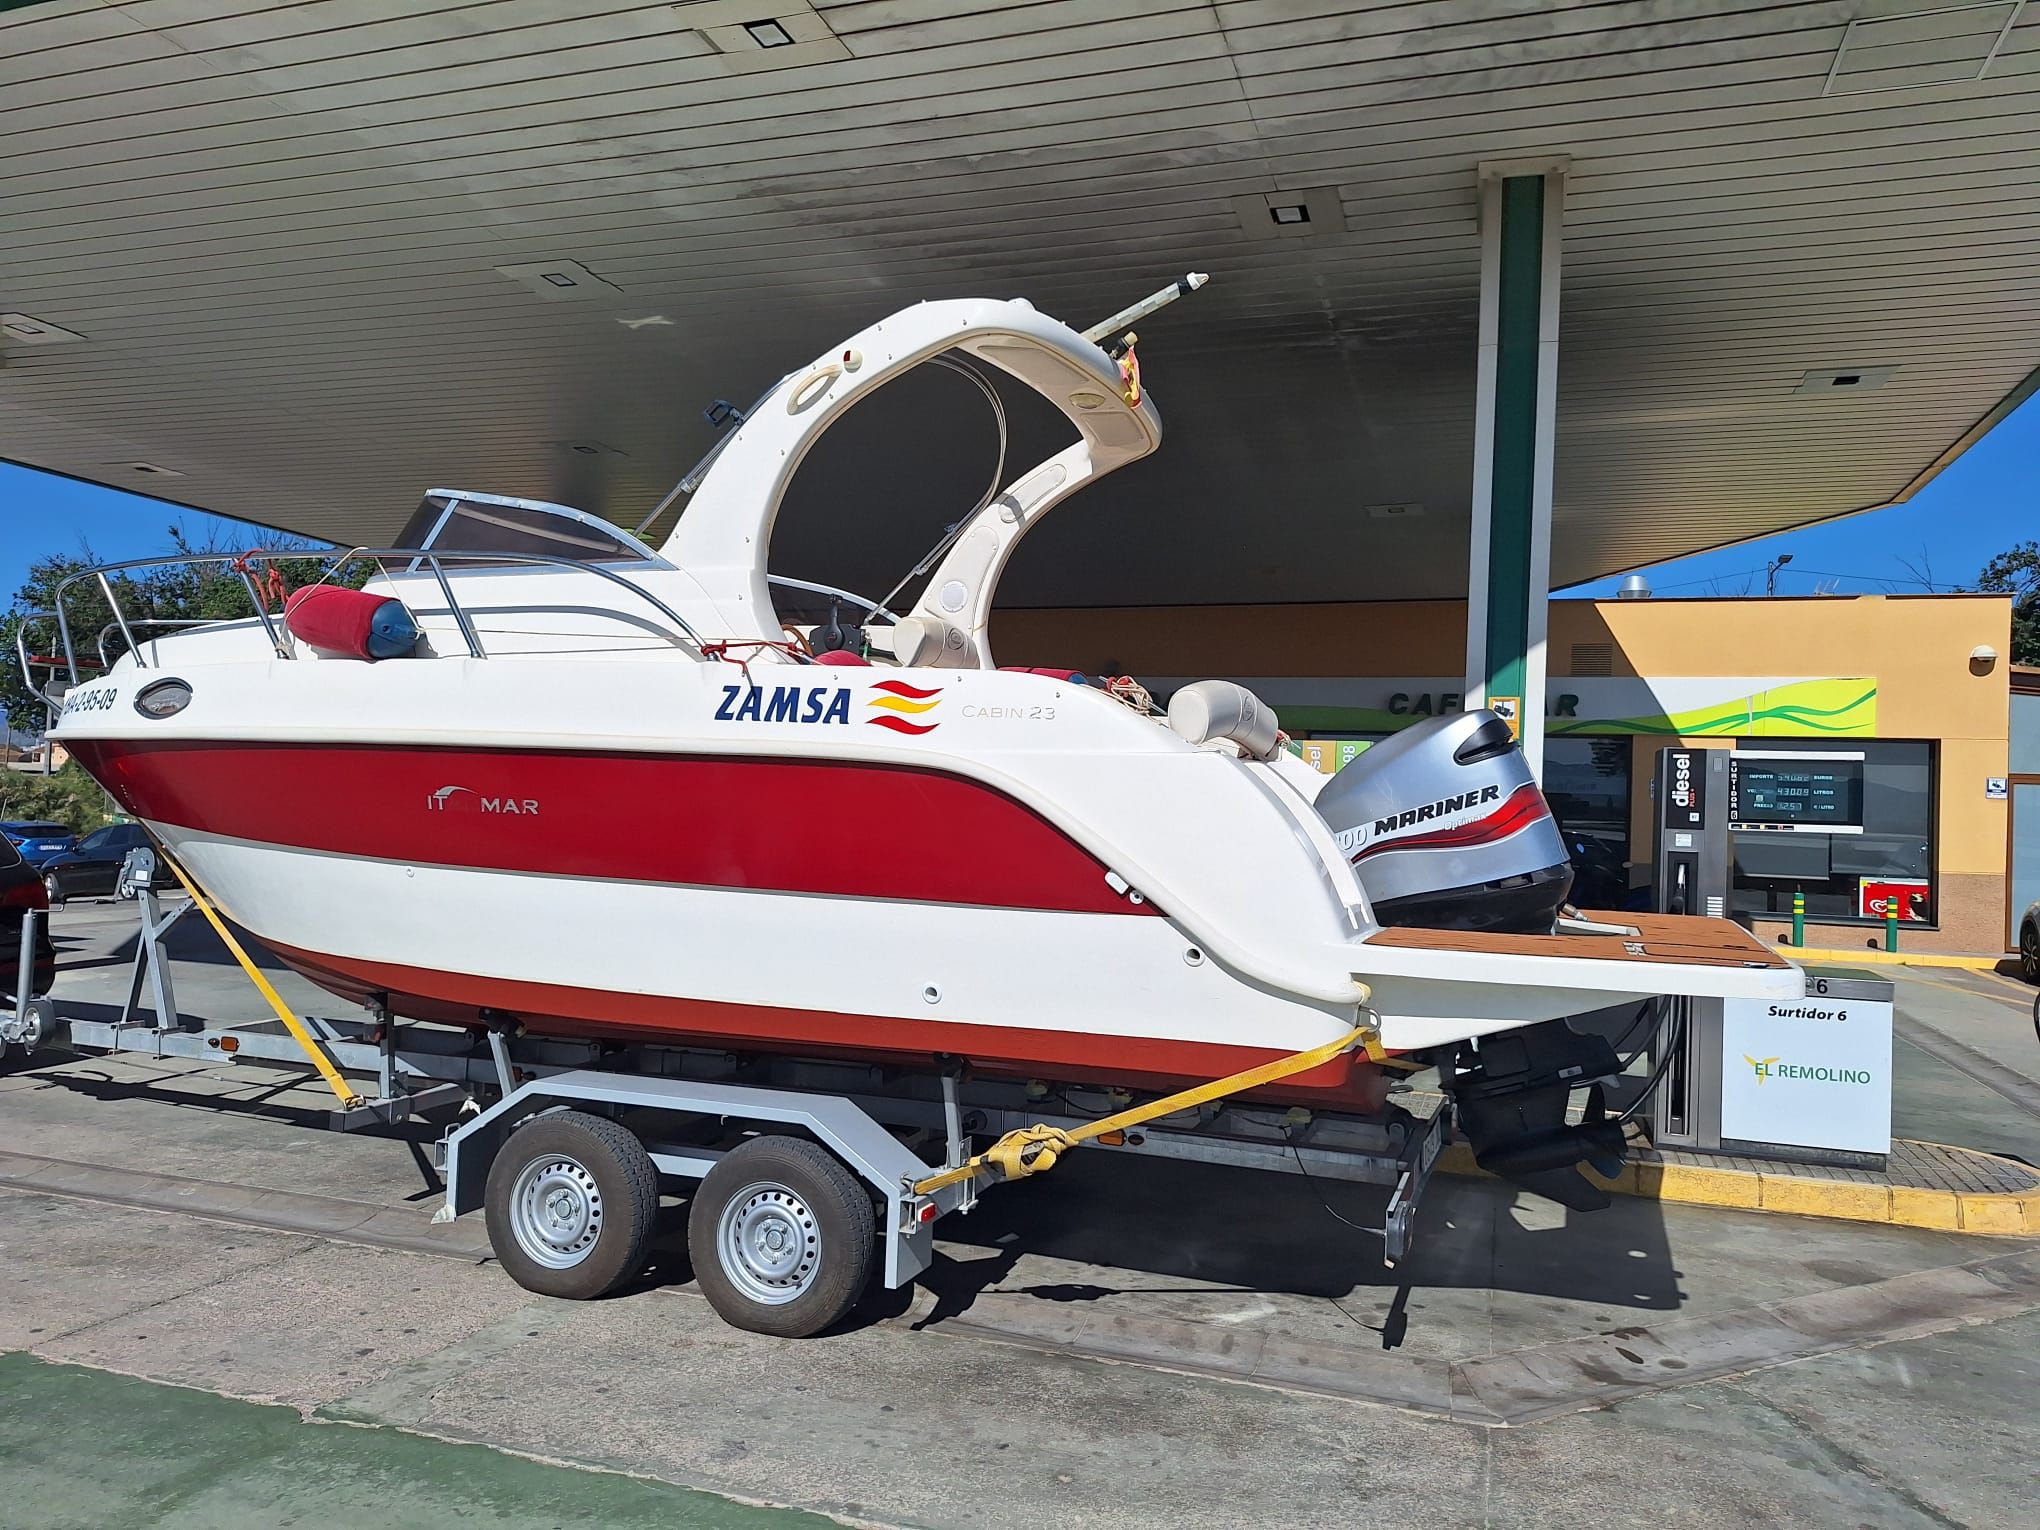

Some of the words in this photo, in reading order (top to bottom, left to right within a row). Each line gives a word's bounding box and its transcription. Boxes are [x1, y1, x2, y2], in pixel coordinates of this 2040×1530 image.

[714, 685, 851, 725] ZAMSA
[1030, 705, 1056, 720] 23
[1388, 693, 1460, 715] CAF
[1307, 746, 1321, 770] sel
[1671, 754, 1690, 807] diesel
[1730, 761, 1738, 808] SURTIDOR
[481, 797, 539, 815] MAR
[1374, 785, 1500, 836] MARINER
[1816, 979, 1828, 994] 6
[1767, 1005, 1834, 1020] Surtidor
[1837, 1010, 1847, 1021] 6
[1755, 1063, 1773, 1077] EL
[1778, 1064, 1871, 1084] REMOLINO
